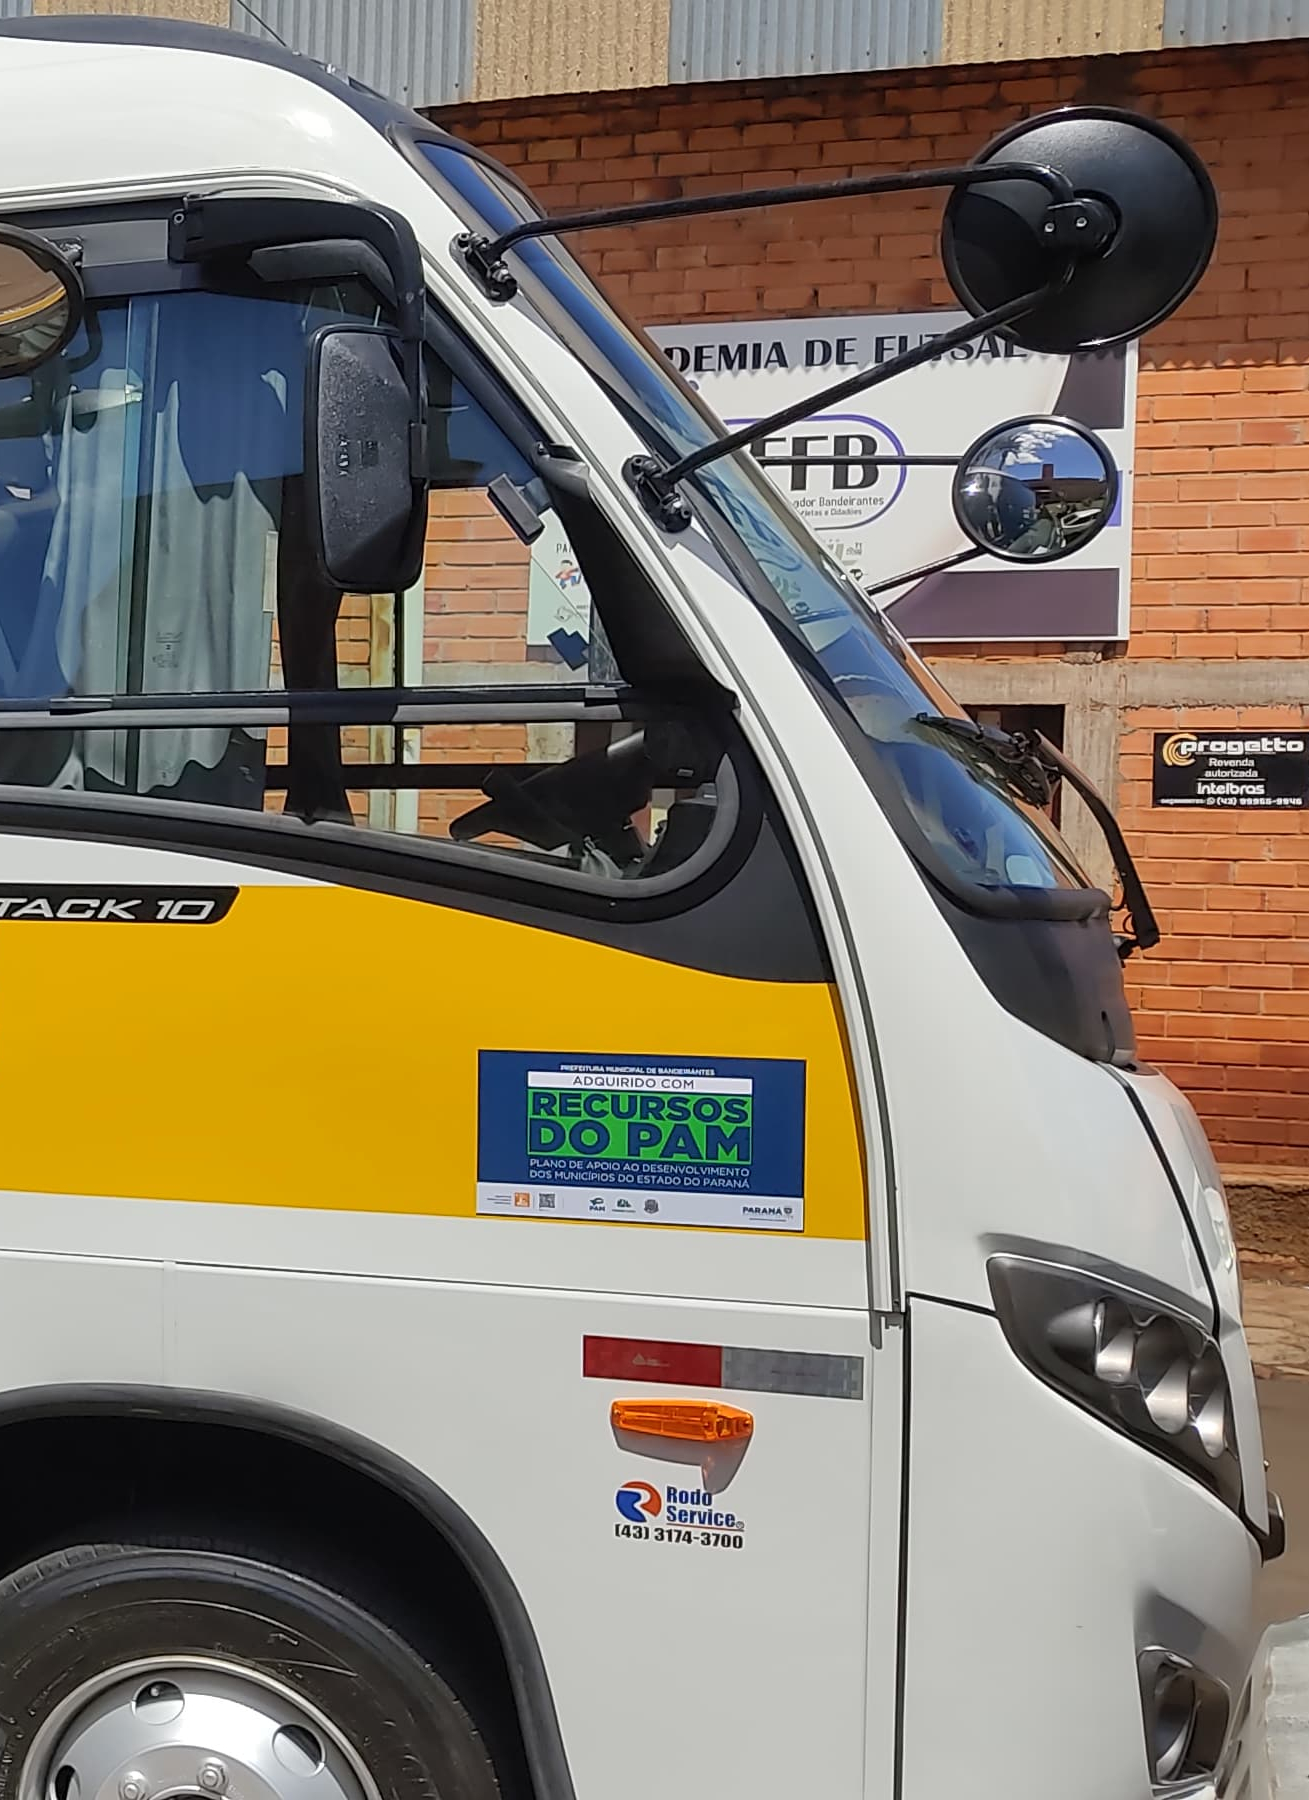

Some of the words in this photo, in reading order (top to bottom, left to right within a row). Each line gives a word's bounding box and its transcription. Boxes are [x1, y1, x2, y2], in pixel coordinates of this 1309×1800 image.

[663, 341, 789, 373] DEMIA
[805, 338, 859, 368] DE
[818, 495, 885, 507] Bandeirantes
[1180, 737, 1305, 755] progetto
[1208, 757, 1255, 767] Revenda
[1204, 768, 1259, 778] autorizada
[156, 900, 217, 921] 10
[646, 1067, 656, 1075] DE
[572, 1075, 656, 1089] ADQUIRIDO
[660, 1078, 695, 1090] COM
[532, 1091, 749, 1124] RECURSOS
[529, 1118, 611, 1155] DO
[627, 1121, 751, 1162] PAM
[529, 1158, 567, 1169] PLANO
[568, 1160, 583, 1170] DE
[586, 1161, 621, 1171] APOIO
[623, 1163, 640, 1172] AO
[642, 1164, 750, 1177] DESENVOLVIMENTO
[529, 1170, 552, 1180] DOS
[554, 1170, 616, 1183] MUNICÍPIOS
[618, 1174, 635, 1184] DO
[637, 1175, 682, 1186] ESTADO
[683, 1177, 701, 1187] DO
[703, 1177, 750, 1189] PARANÁ
[666, 1485, 713, 1507] Rodo
[666, 1505, 736, 1528] Service
[614, 1523, 650, 1540] (43)
[654, 1527, 744, 1550] 3174-3700
